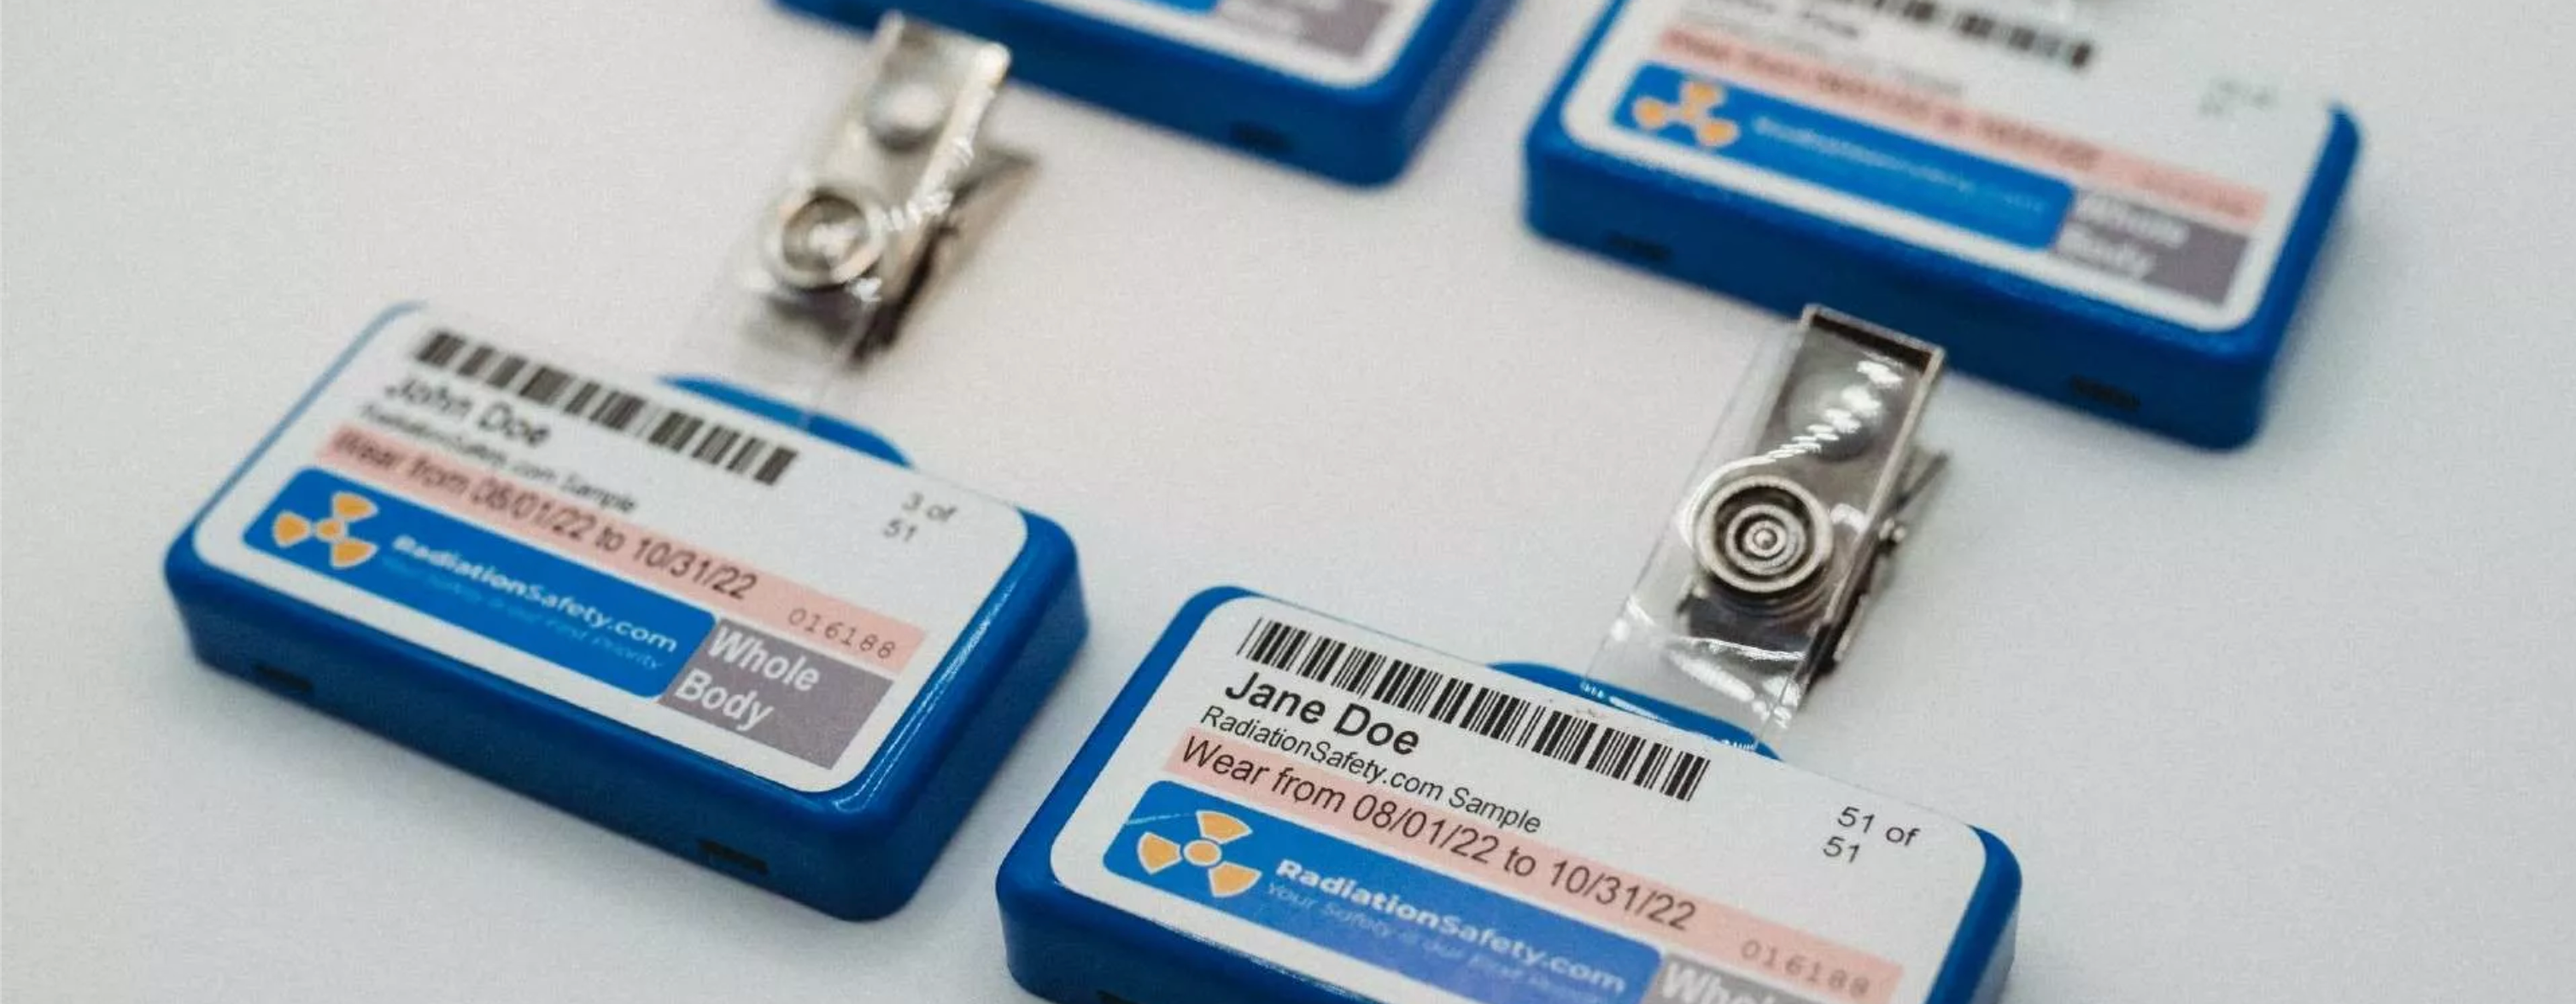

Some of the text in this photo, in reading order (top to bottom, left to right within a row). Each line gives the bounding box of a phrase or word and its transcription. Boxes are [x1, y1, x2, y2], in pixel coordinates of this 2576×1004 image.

[384, 376, 551, 448] John Doe
[331, 427, 758, 601] Wear from 08/01/22 to 10/31/22
[882, 517, 920, 544] 51
[901, 491, 957, 524] 3 of
[391, 534, 679, 654] RadiationSafety.com
[705, 626, 821, 692] Whole
[787, 607, 898, 661] 016188
[674, 669, 776, 733] Body
[1225, 671, 1420, 756] Jane Doe
[1200, 704, 1542, 834] RadiationSafety.com Sample
[1182, 735, 1697, 931] Wear from 08/01/22 to 10/31/22
[1822, 837, 1861, 865] 51
[1836, 805, 1920, 847] 51 of
[1275, 859, 1626, 994] RadiationSafety.com
[1740, 939, 1871, 999] 016188
